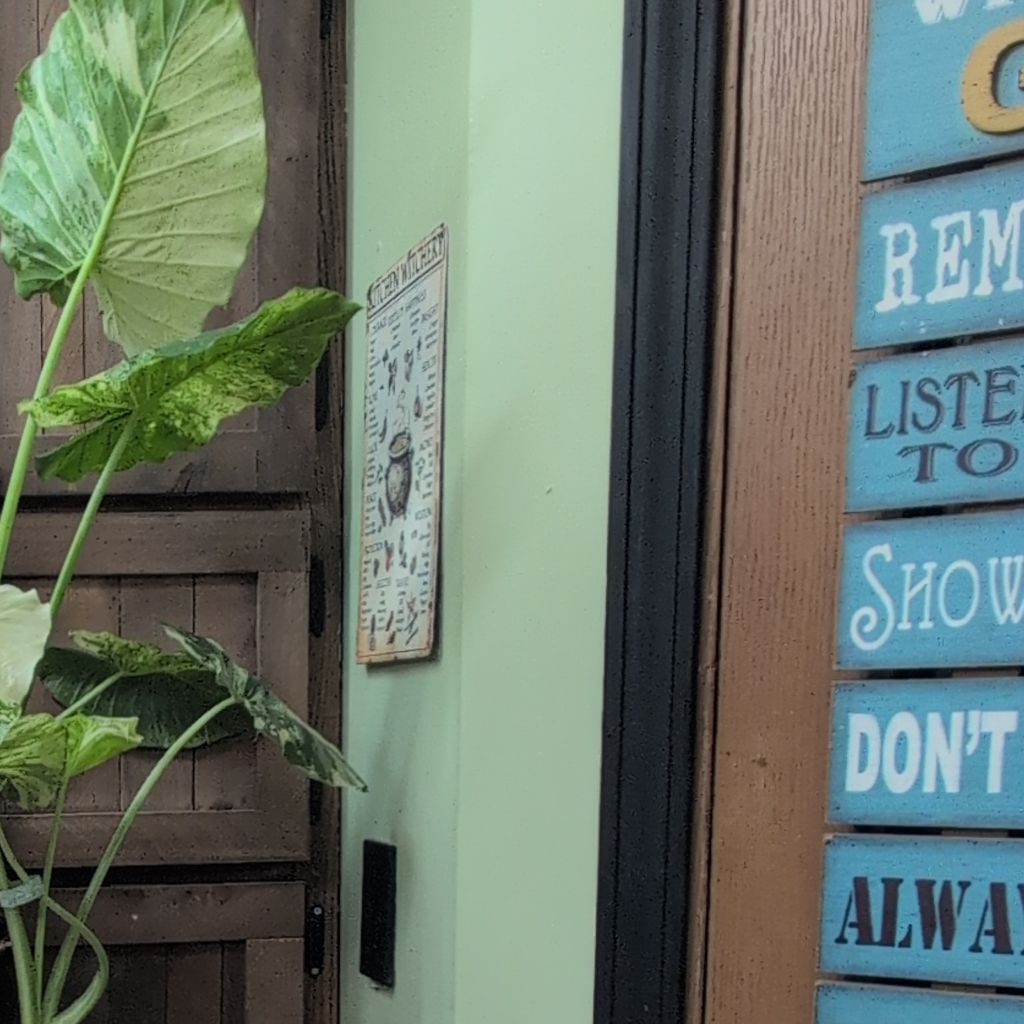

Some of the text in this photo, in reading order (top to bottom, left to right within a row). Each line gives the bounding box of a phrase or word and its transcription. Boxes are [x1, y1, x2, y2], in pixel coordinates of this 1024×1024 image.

[876, 200, 1024, 314] REM
[864, 364, 1024, 440] LISTE
[897, 438, 1019, 484] TO
[845, 710, 1019, 794] DON'T
[834, 876, 1024, 955] ALWA
